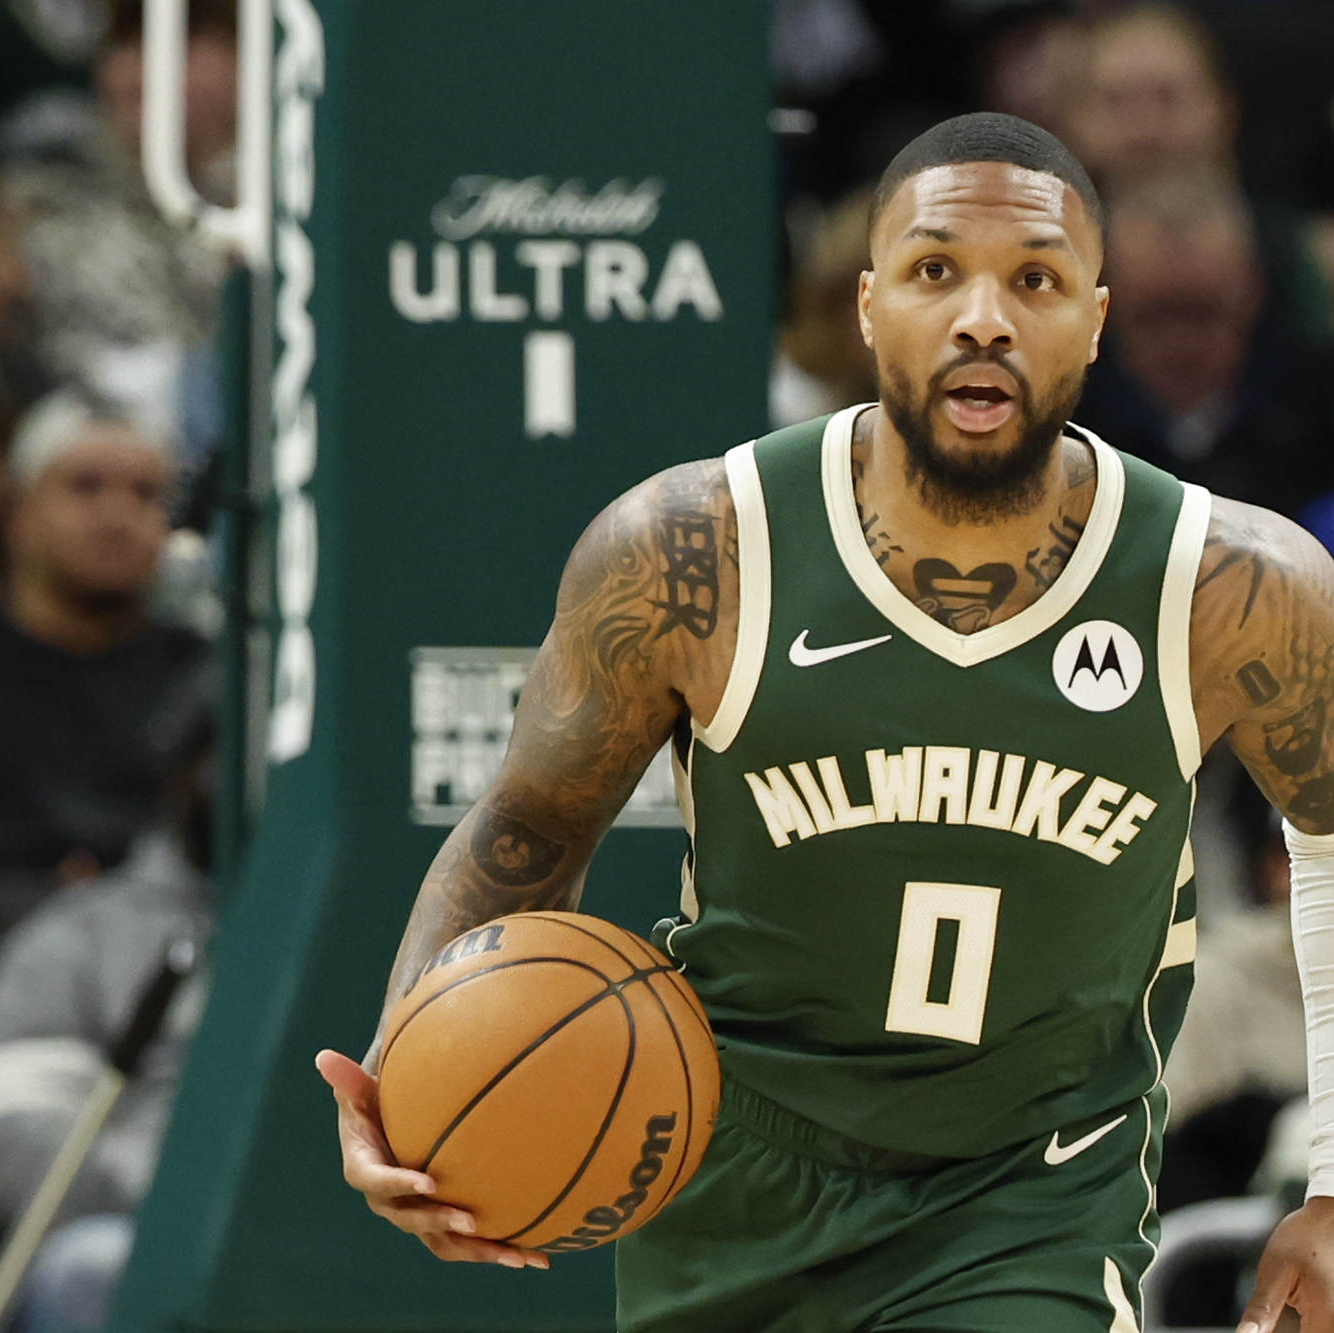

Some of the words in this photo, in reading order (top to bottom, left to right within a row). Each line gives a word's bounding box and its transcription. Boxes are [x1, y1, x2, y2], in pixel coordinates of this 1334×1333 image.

[388, 238, 725, 323] ULTRA
[744, 745, 1158, 866] MILWAUKEE
[884, 881, 1002, 1046] 0
